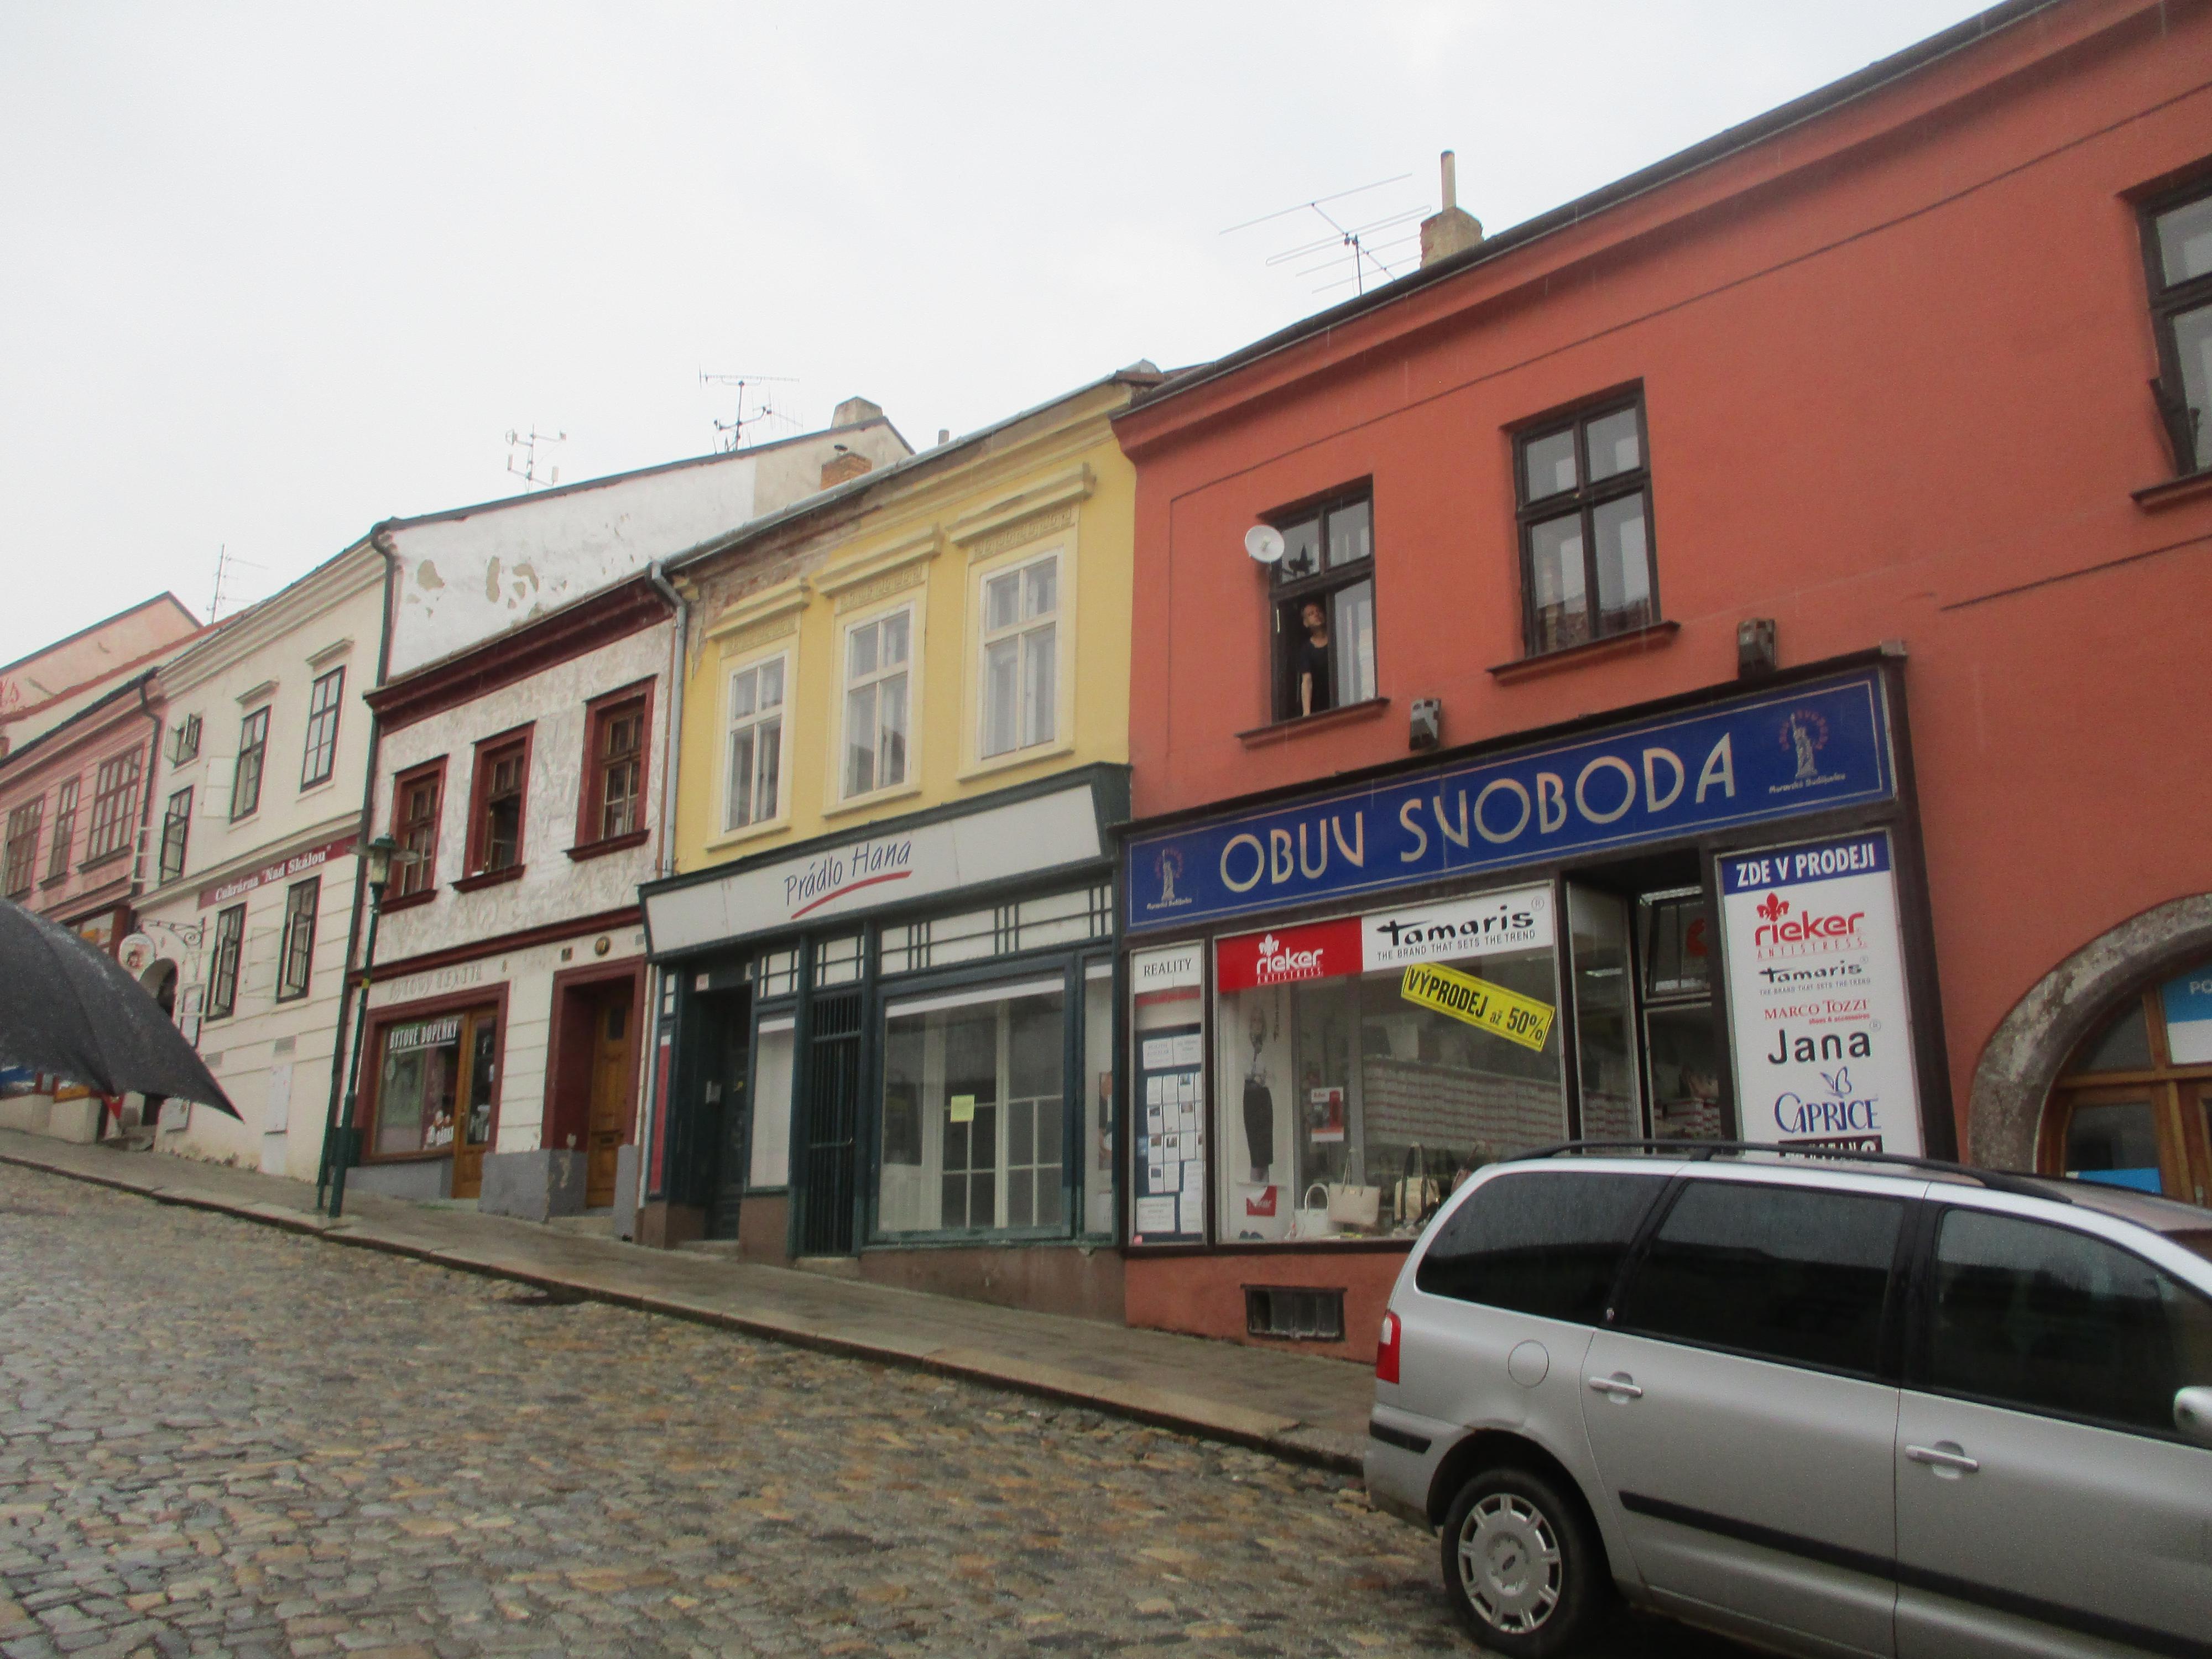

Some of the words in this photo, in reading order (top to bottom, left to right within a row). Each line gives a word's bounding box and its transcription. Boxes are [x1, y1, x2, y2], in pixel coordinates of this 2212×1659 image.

[1220, 811, 1364, 893] OBUV
[1400, 733, 1735, 863] SVOBODA
[784, 855, 842, 906] Prádlo
[852, 841, 911, 877] Hana
[1736, 859, 1771, 888] ZDE
[1775, 856, 1790, 881] V
[1796, 843, 1876, 878] PRODEJI
[1377, 951, 1394, 961] THE
[1397, 946, 1427, 958] BRAND
[1431, 943, 1453, 953] THAT
[1458, 938, 1480, 949] SETS
[1484, 935, 1502, 946] THE
[1505, 929, 1536, 943] TREND
[1755, 910, 1865, 947] rieker
[1144, 957, 1192, 977] REALITY
[1256, 947, 1323, 974] rieker
[1408, 969, 1489, 1018] VÝPRODEJ
[1490, 1009, 1503, 1025] až
[1506, 1006, 1545, 1041] 50%
[1764, 1003, 1820, 1020] MARCO
[1823, 998, 1868, 1014] TOZZI
[1768, 1028, 1871, 1064] Jana
[1774, 1092, 1881, 1133] CAPRICE
